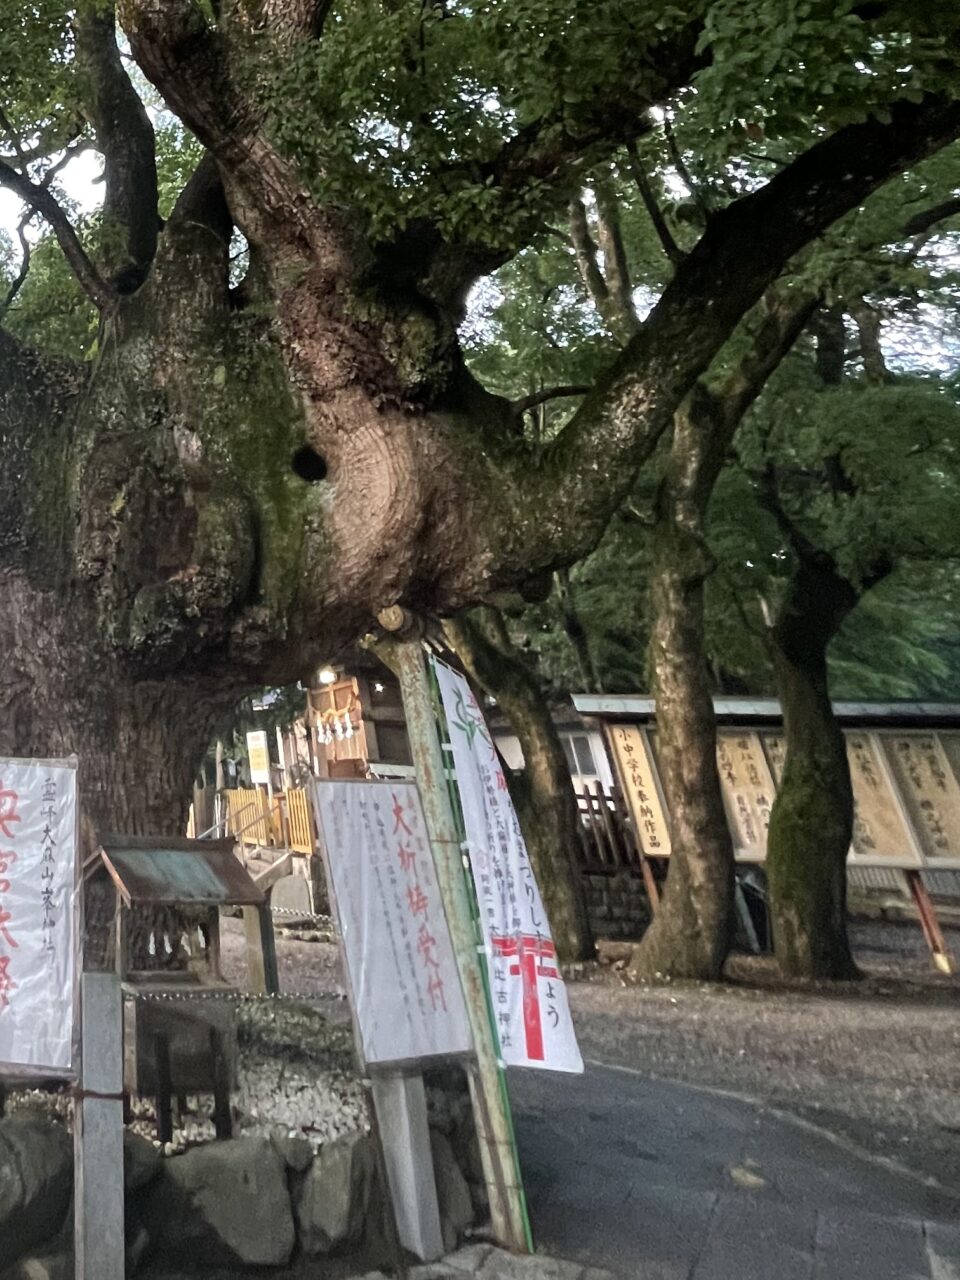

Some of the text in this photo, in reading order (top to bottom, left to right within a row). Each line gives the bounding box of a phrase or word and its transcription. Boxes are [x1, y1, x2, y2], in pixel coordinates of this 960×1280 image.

[618, 729, 661, 848] 小中学校奉納作品
